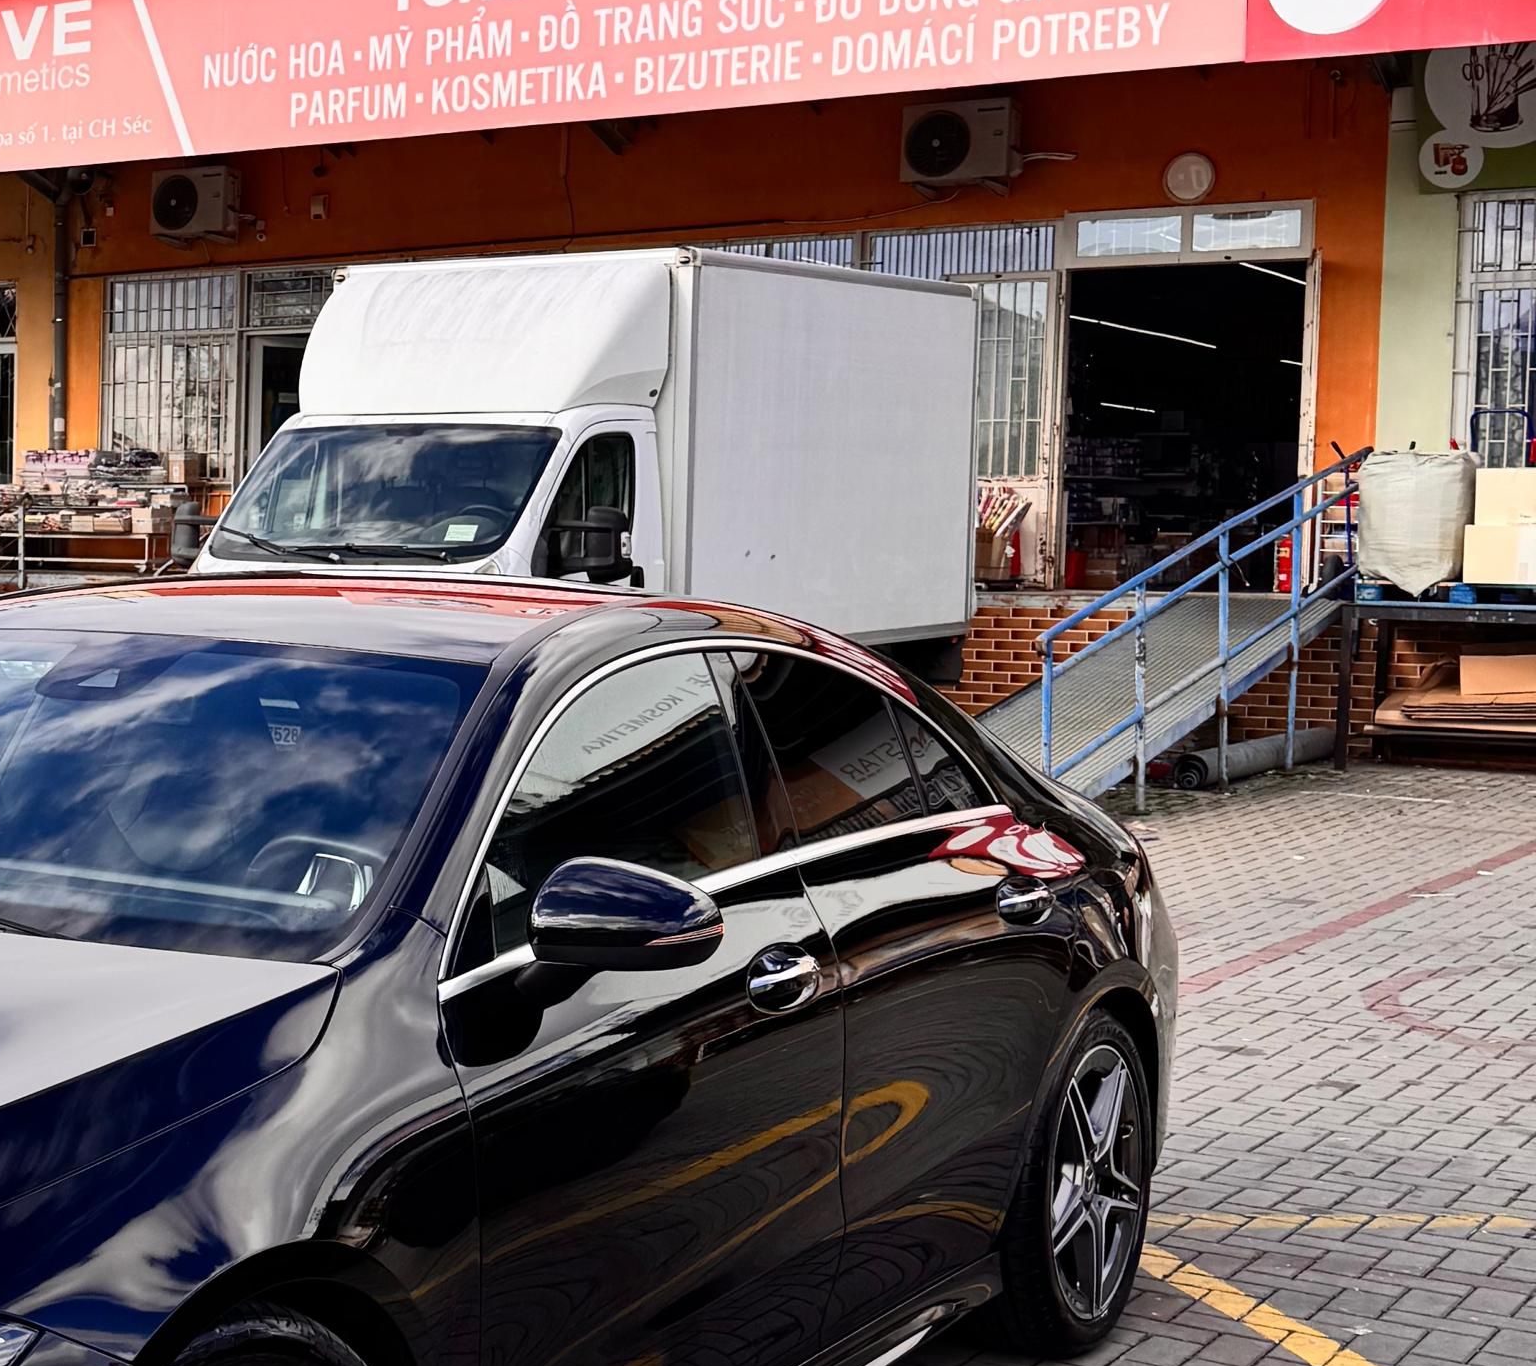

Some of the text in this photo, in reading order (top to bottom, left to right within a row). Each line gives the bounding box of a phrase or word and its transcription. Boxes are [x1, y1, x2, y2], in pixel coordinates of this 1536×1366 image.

[203, 41, 277, 89] NƯỚC
[288, 39, 345, 80] HOA
[369, 27, 413, 71] MỸ
[425, 6, 512, 66] PHẨM
[289, 2, 1170, 128] PARFUM KOSMETIKA BIZUTERIE DOMÁCÍ POTREBY
[17, 121, 38, 145] số
[61, 120, 83, 145] tại
[88, 119, 116, 139] CH
[122, 115, 152, 135] Séc
